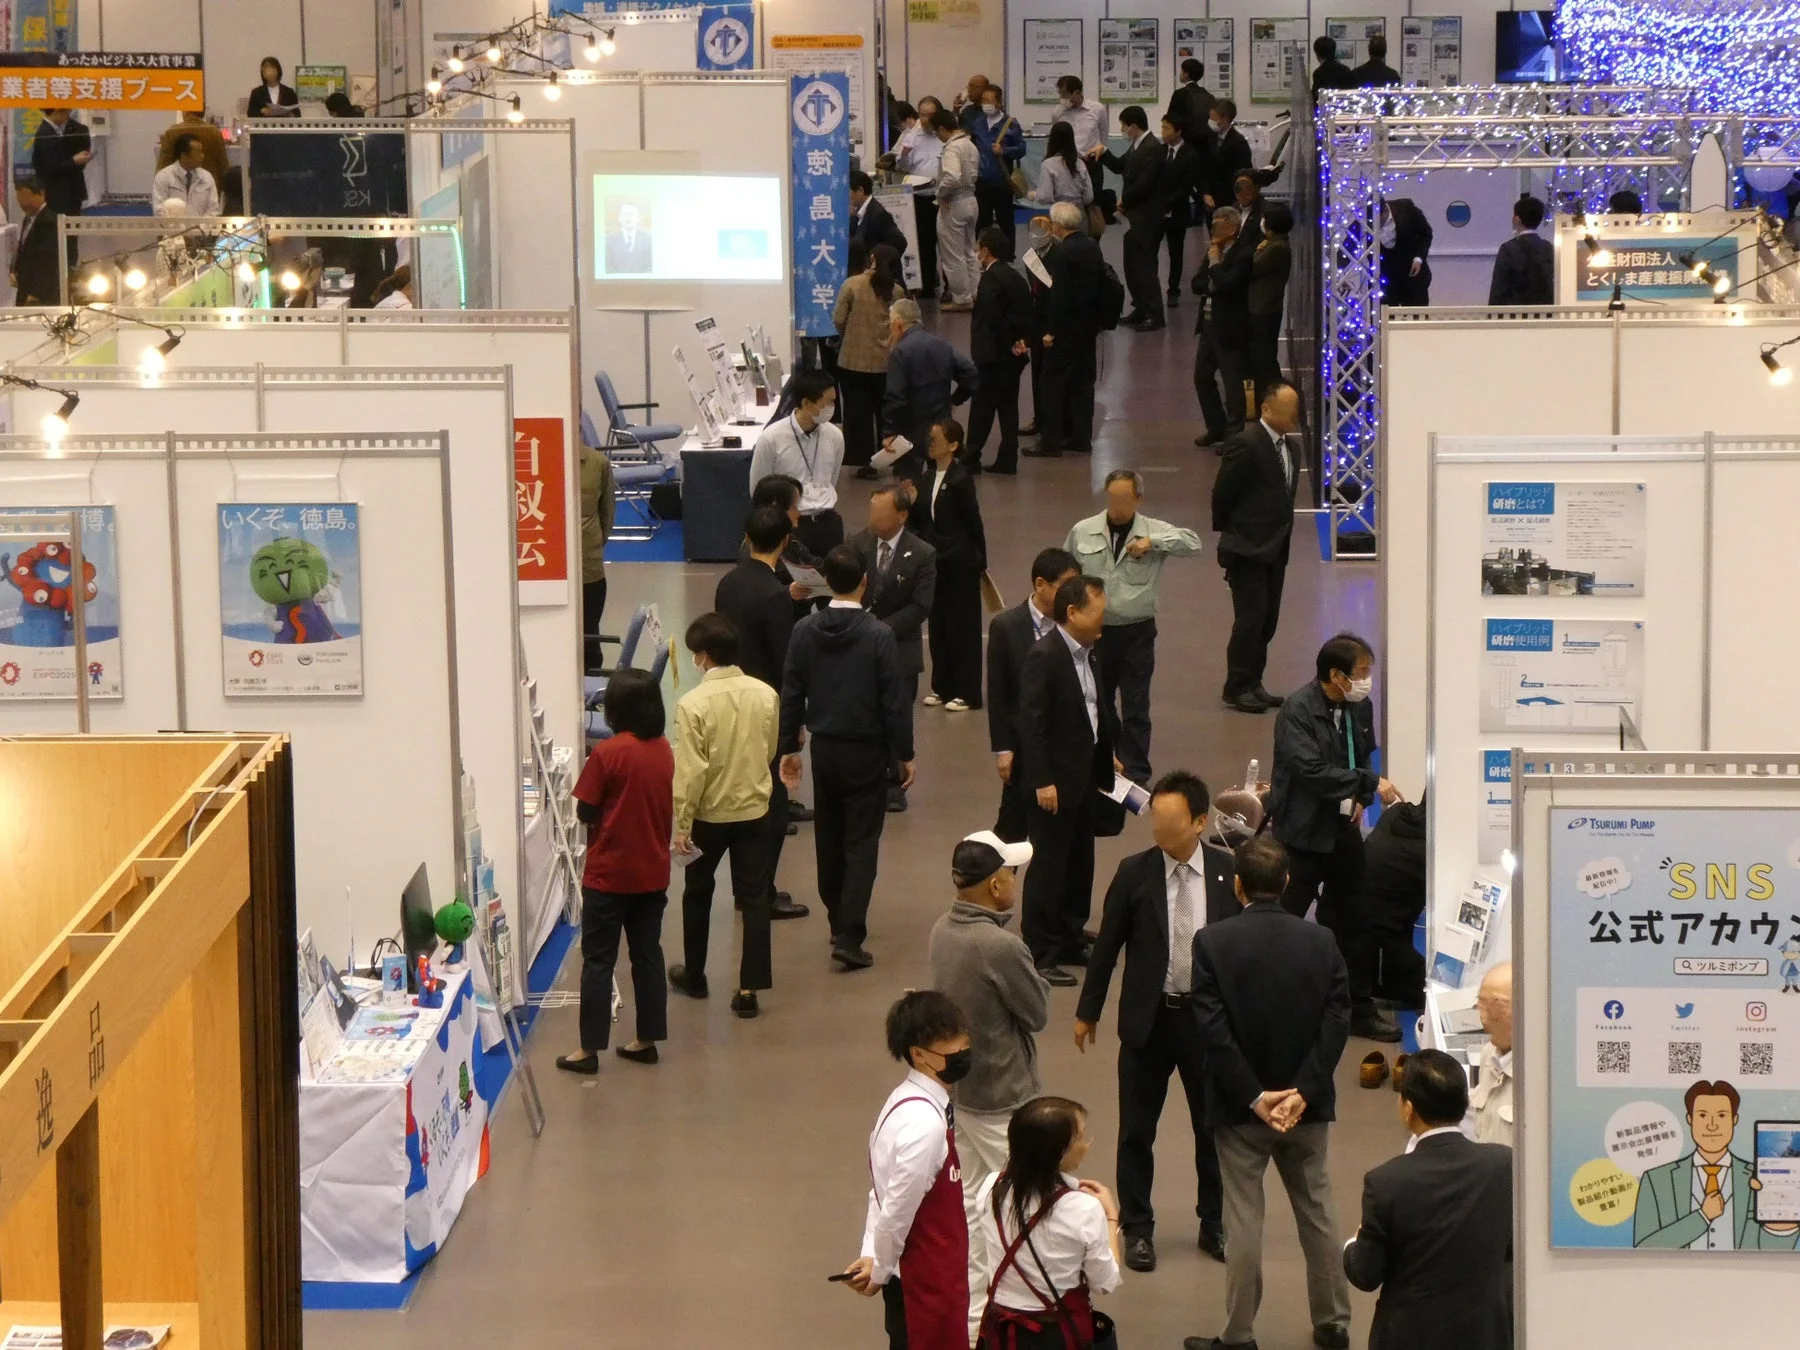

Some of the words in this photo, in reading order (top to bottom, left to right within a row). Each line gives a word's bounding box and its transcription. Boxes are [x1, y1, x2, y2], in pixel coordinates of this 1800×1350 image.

[58, 54, 196, 68] あったかビジネス大賞事業
[1, 76, 198, 101] 業者等支援ブース
[222, 507, 356, 530] いくぞ、徳島。
[1589, 818, 1628, 829] TSURUMI
[1630, 818, 1655, 829] PUMP
[1668, 862, 1775, 901] SNS
